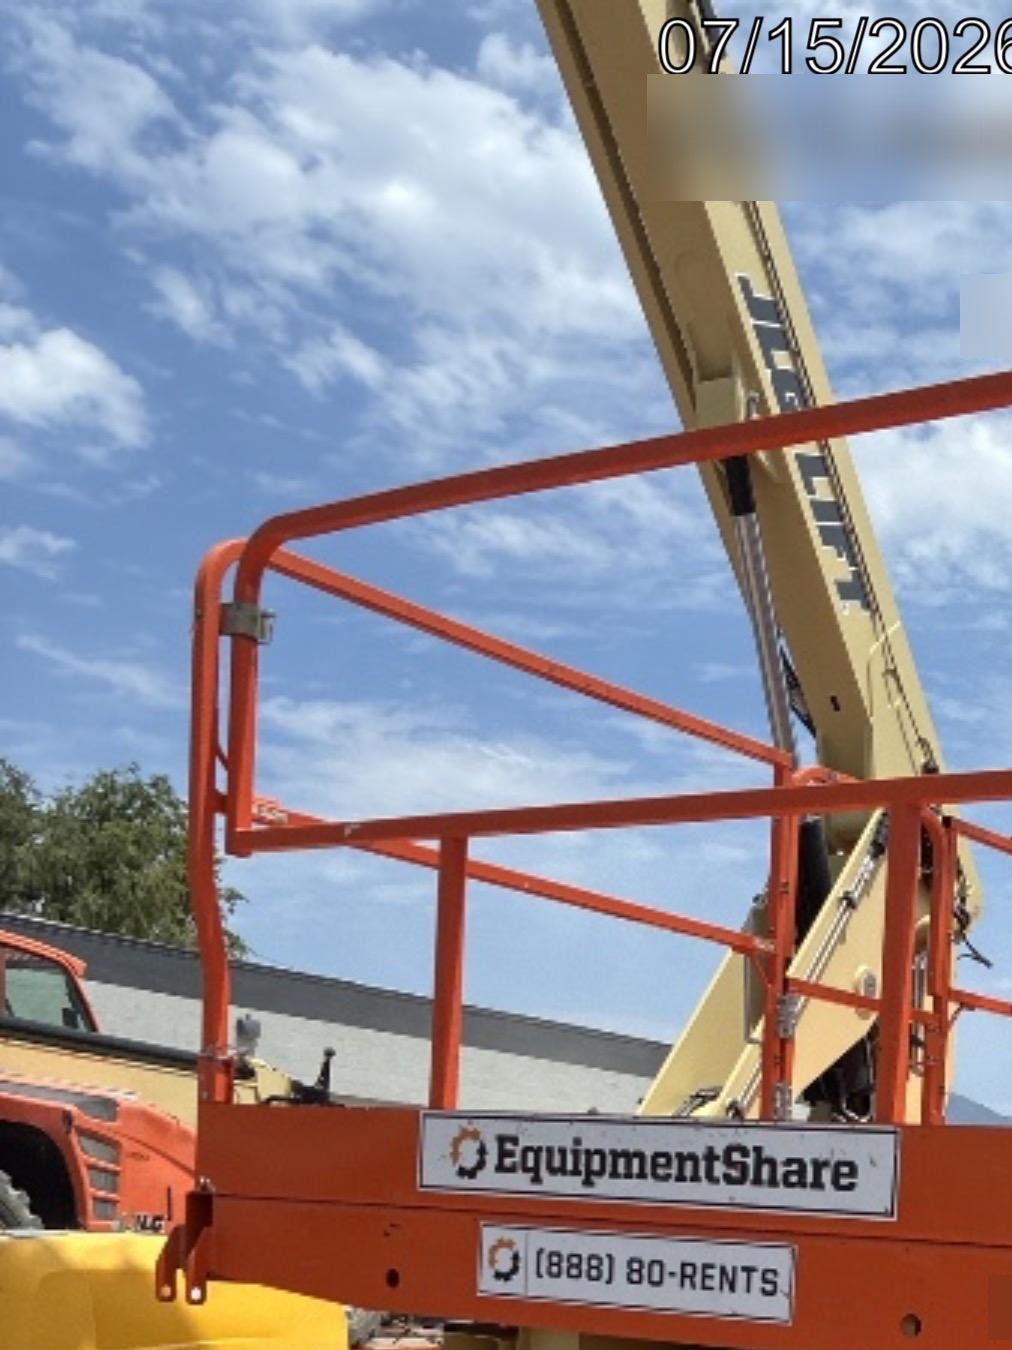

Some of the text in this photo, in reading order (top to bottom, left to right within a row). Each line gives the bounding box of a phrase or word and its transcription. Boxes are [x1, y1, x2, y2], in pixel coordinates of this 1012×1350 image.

[796, 453, 871, 612] LIFT
[494, 1134, 858, 1191] EquipmentShare
[536, 1246, 780, 1298] (888) 80-RENTS
